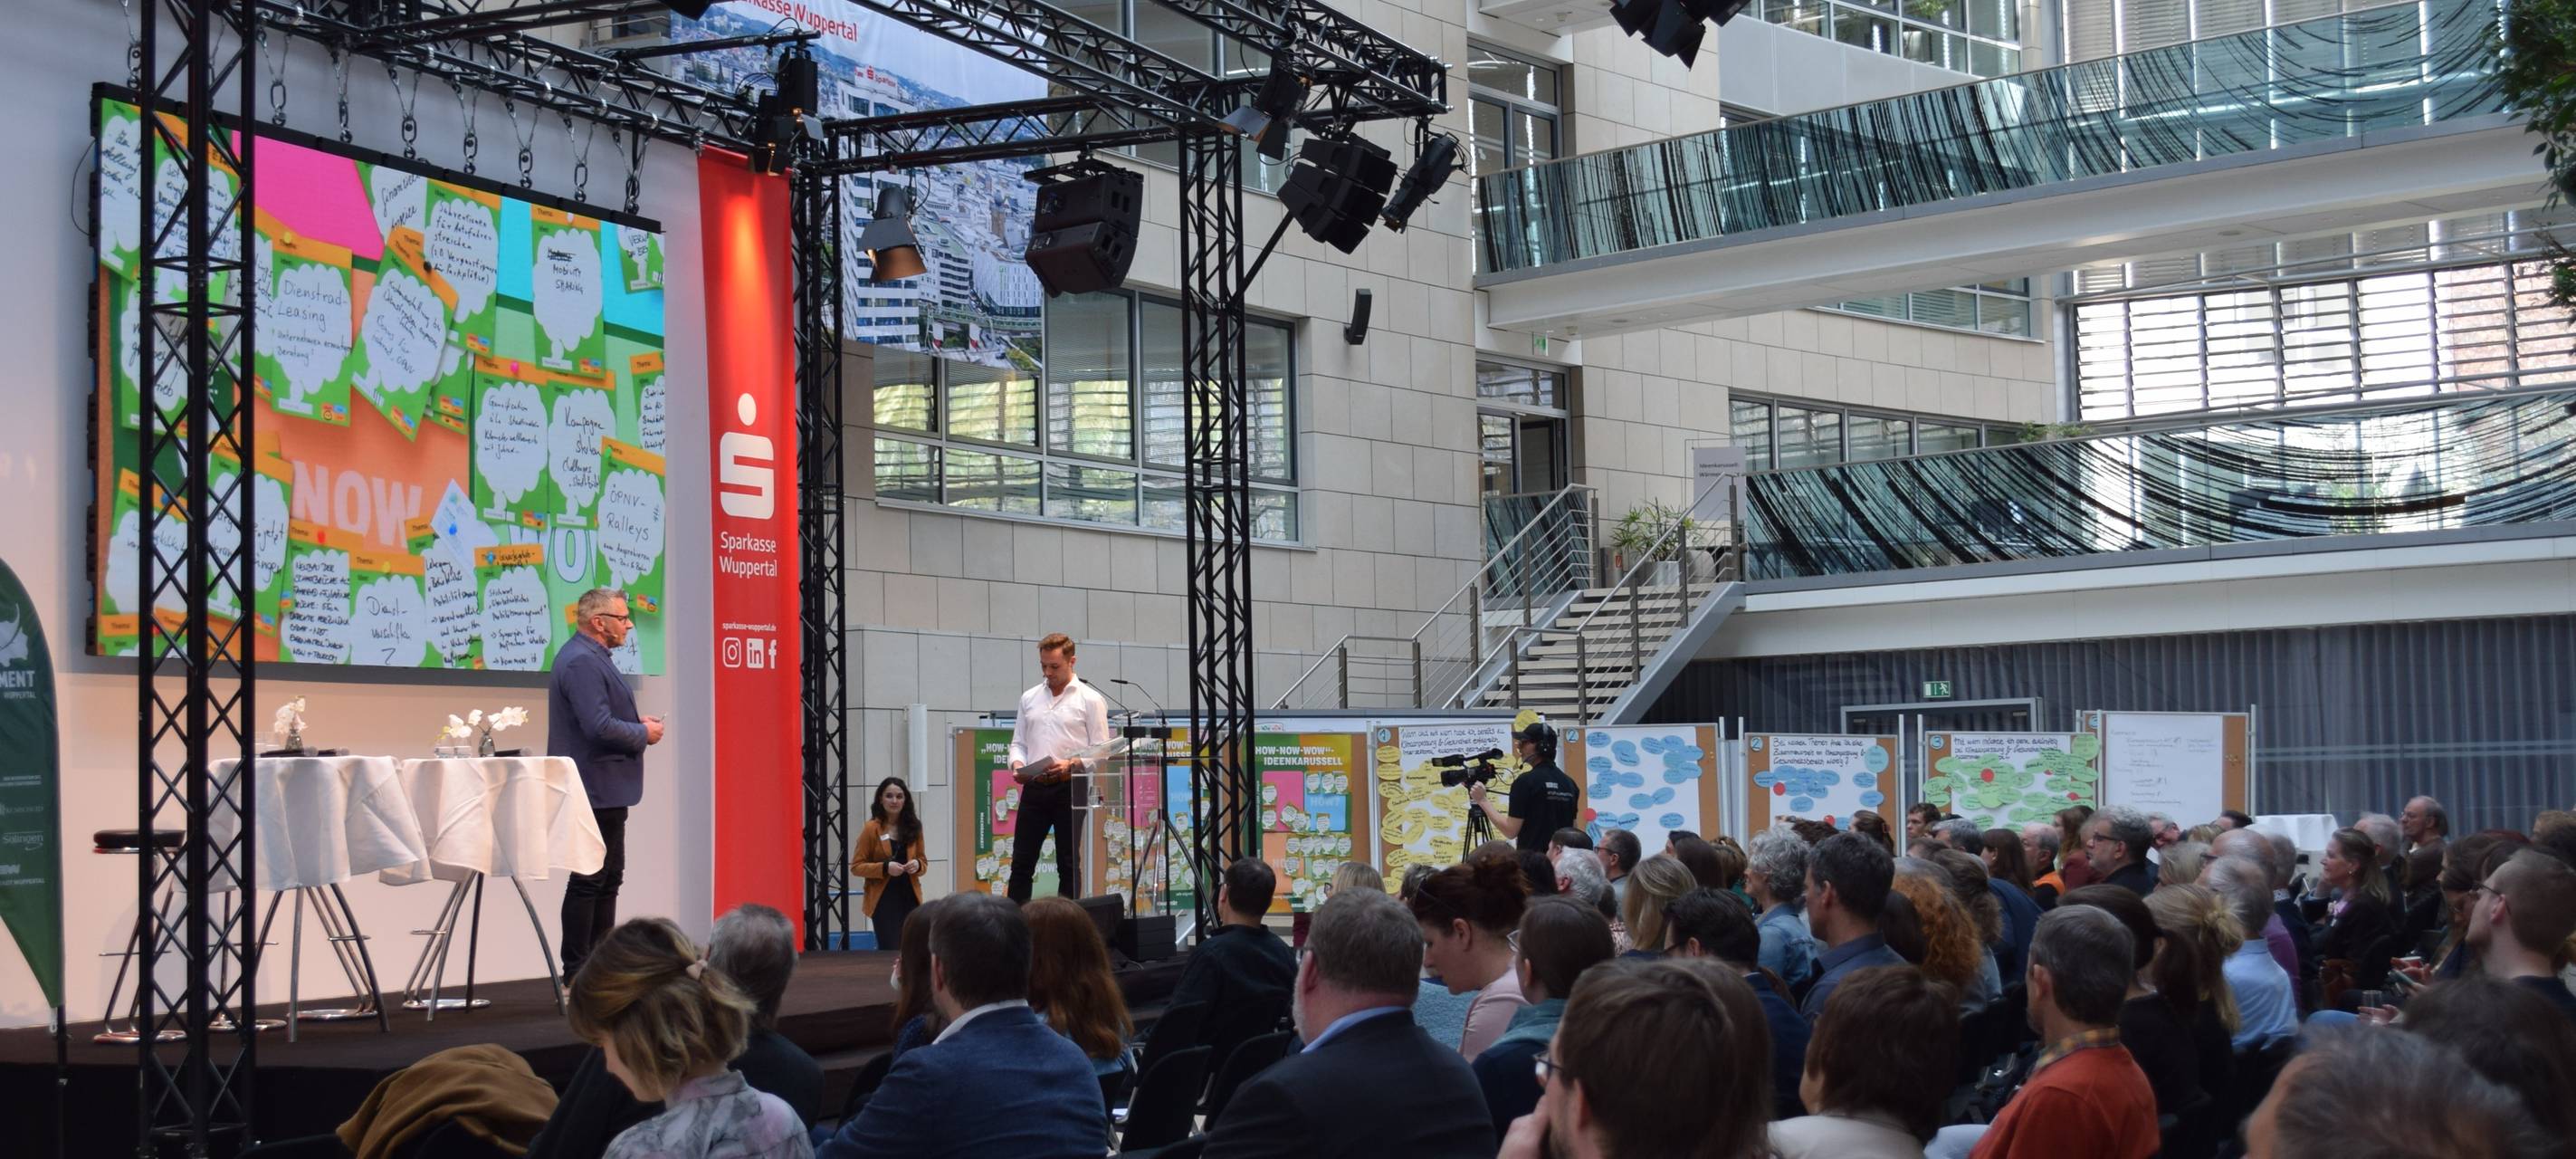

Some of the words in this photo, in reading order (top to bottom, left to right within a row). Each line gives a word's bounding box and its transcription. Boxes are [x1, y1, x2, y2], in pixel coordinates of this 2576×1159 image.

[794, 3, 857, 42] Wuppertal
[283, 279, 348, 305] Dienstrad-
[277, 301, 326, 332] Leasing
[292, 460, 423, 550] NOW
[610, 484, 645, 507] ÖPNV-
[606, 512, 649, 542] Ralleys
[720, 532, 777, 553] Sparkasse
[720, 555, 778, 579] Wuppertal
[366, 596, 407, 616] Dienst-
[1568, 730, 1577, 742] 2
[1752, 738, 1760, 749] 2
[1932, 736, 1942, 748] 3
[1264, 756, 1343, 766] IDEENKARUSSELL
